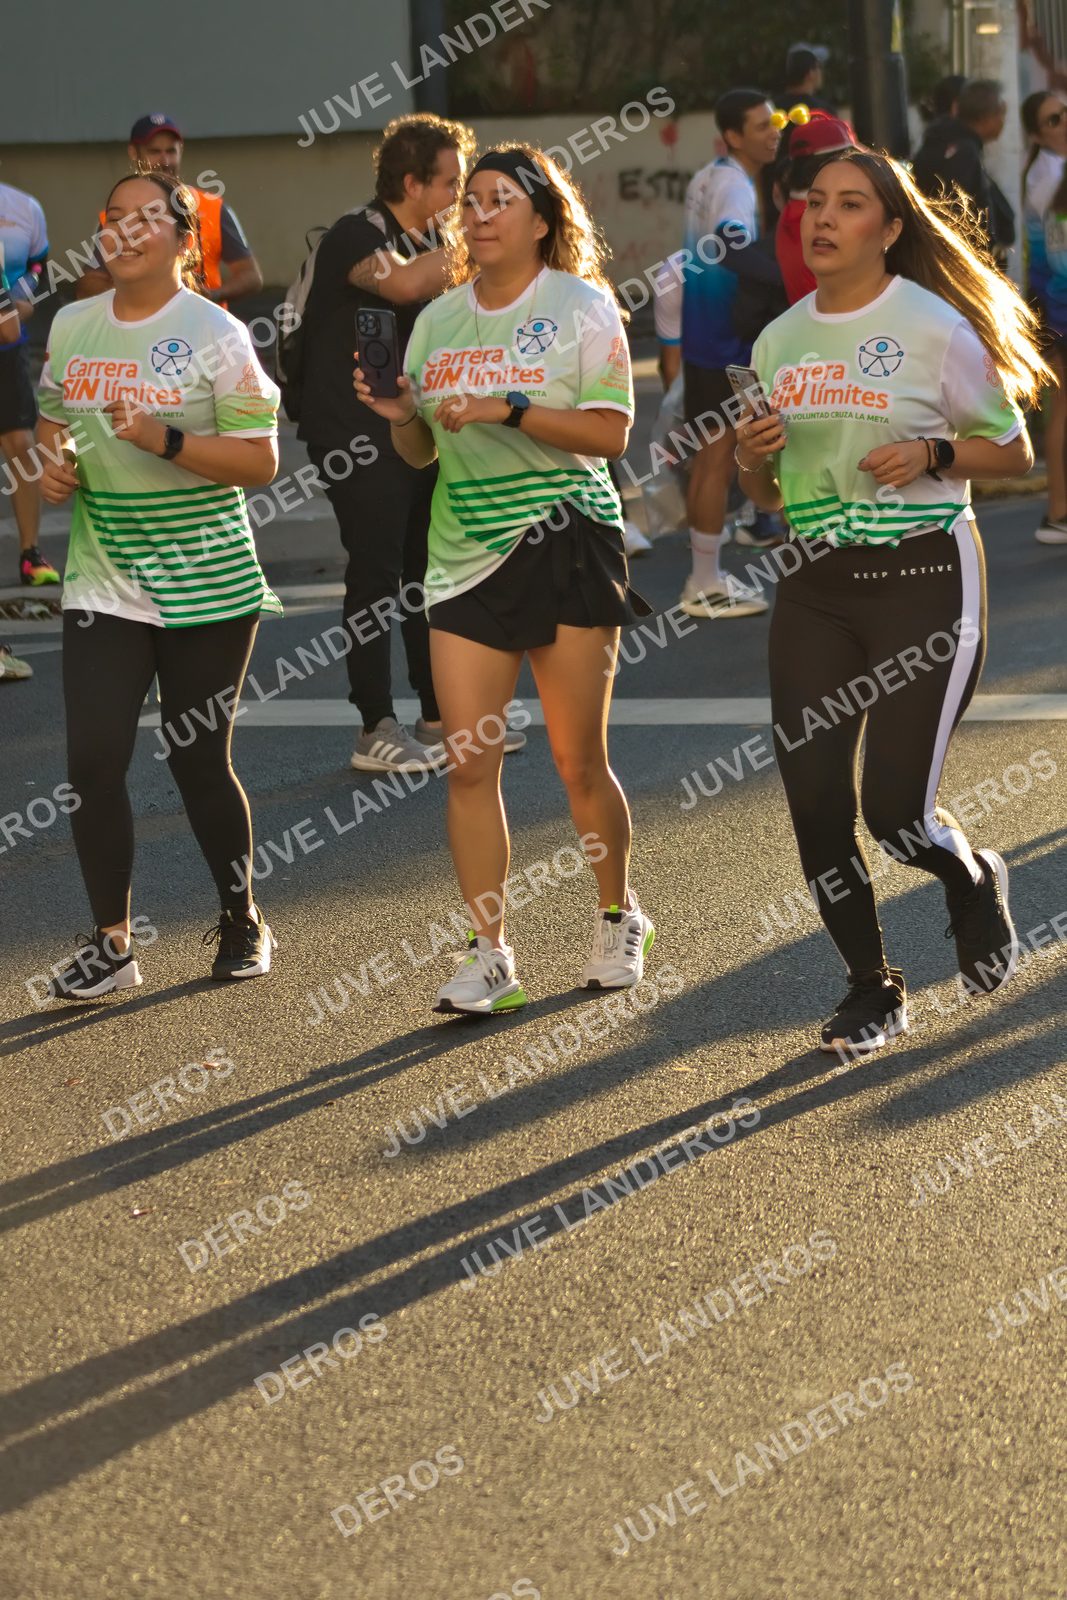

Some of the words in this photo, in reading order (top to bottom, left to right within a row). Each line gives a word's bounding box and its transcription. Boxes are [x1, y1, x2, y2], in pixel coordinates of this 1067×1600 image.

[67, 358, 137, 378] Carrera
[422, 366, 464, 392] SIN
[468, 365, 545, 386] límites
[63, 379, 100, 400] SIN
[104, 380, 182, 405] límites
[810, 382, 888, 410] límites
[791, 412, 830, 420] VOLUNTAD
[831, 411, 853, 419] CRUZA
[855, 412, 864, 420] LA
[866, 414, 890, 424] META
[853, 571, 888, 579] KEEP
[900, 564, 953, 576] ACTIVE
